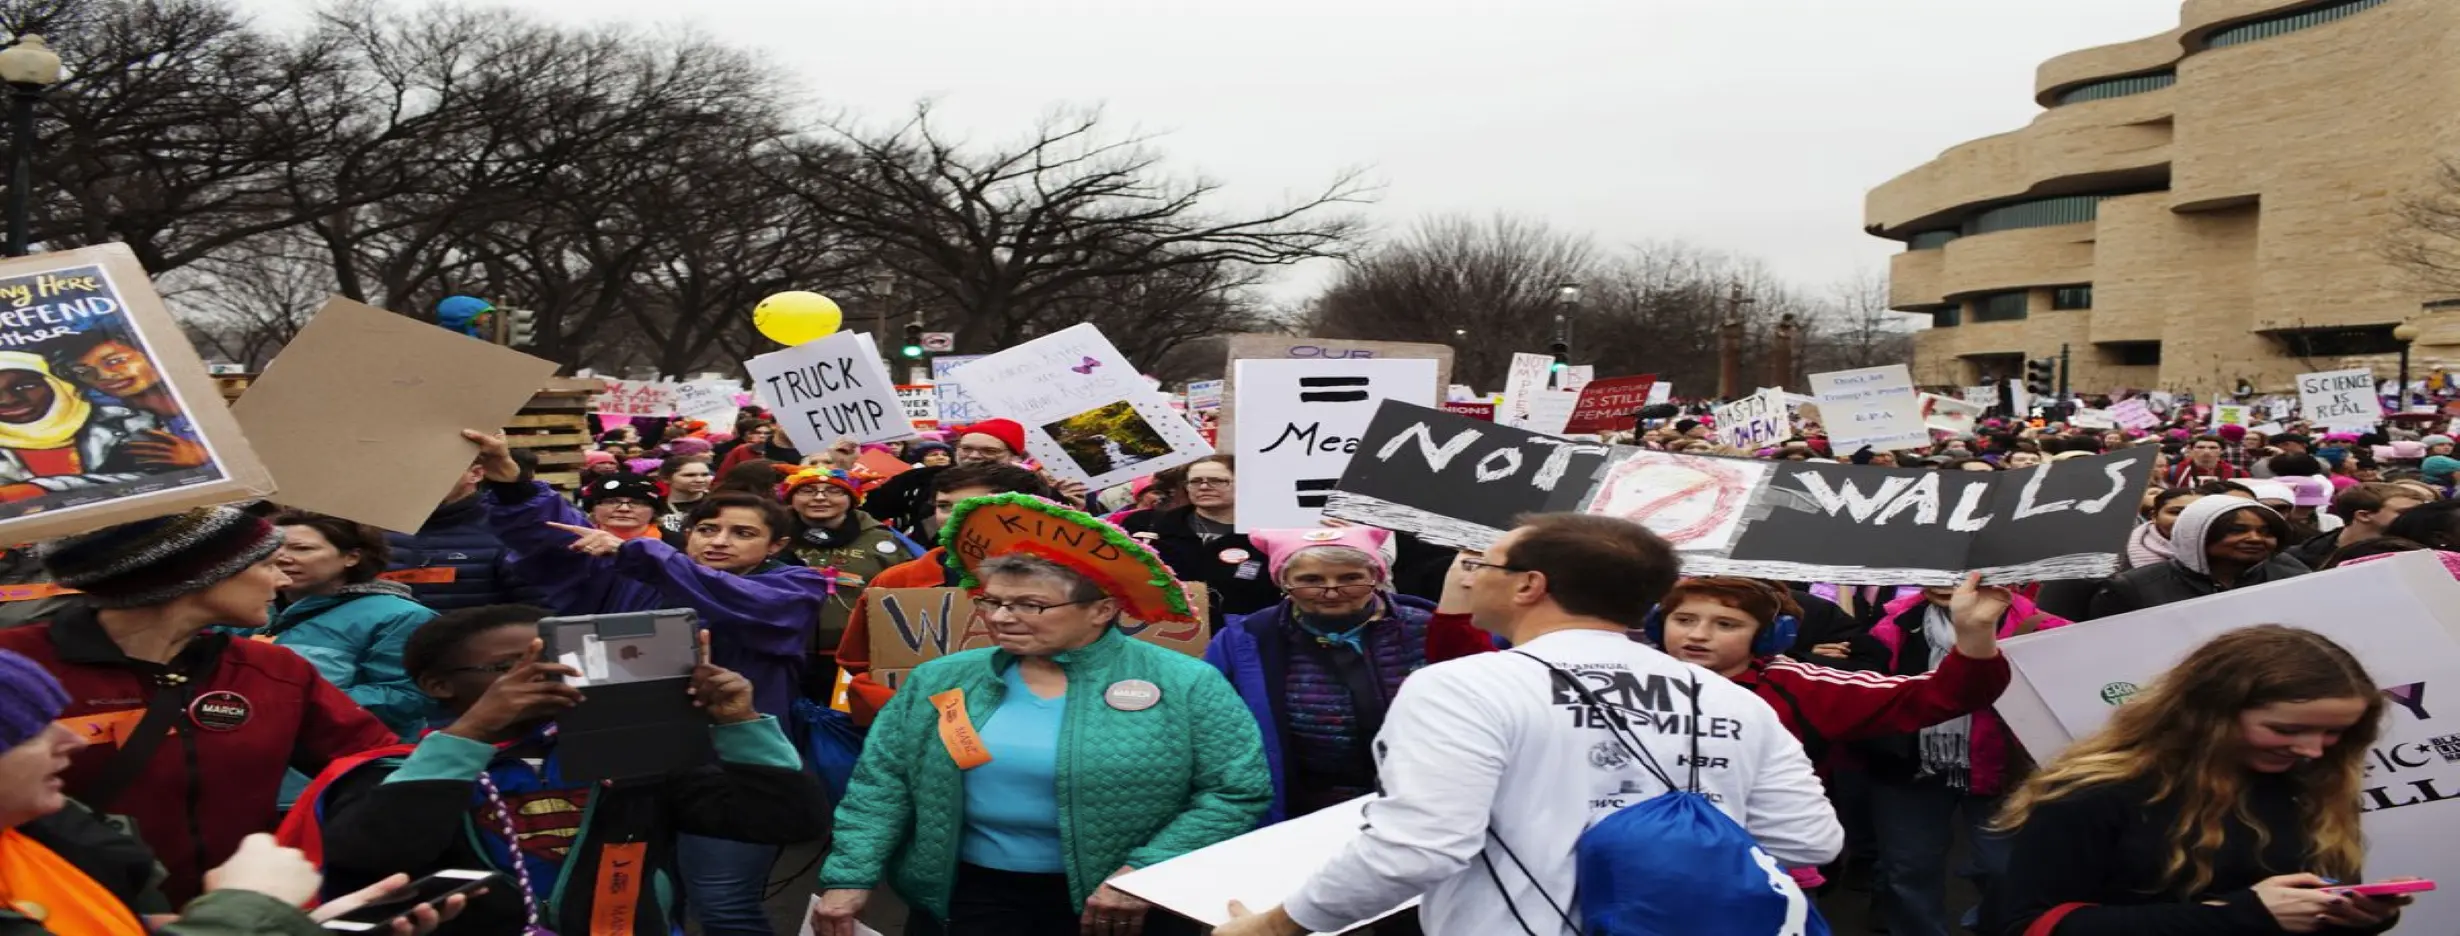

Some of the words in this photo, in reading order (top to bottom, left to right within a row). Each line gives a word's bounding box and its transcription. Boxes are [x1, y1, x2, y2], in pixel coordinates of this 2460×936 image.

[1290, 345, 1374, 359] OUR
[766, 357, 862, 407] TRUCK
[2304, 374, 2372, 394] SCIENCE
[1440, 405, 1491, 415] NIONS
[1579, 398, 1596, 408] IS
[1600, 393, 1644, 407] STILL
[806, 399, 884, 441] FUMP
[2315, 402, 2369, 420] REAL
[1791, 457, 2138, 532] WALLS
[961, 528, 990, 561] BE
[995, 514, 1120, 561] KIND
[202, 703, 245, 717] MARCH
